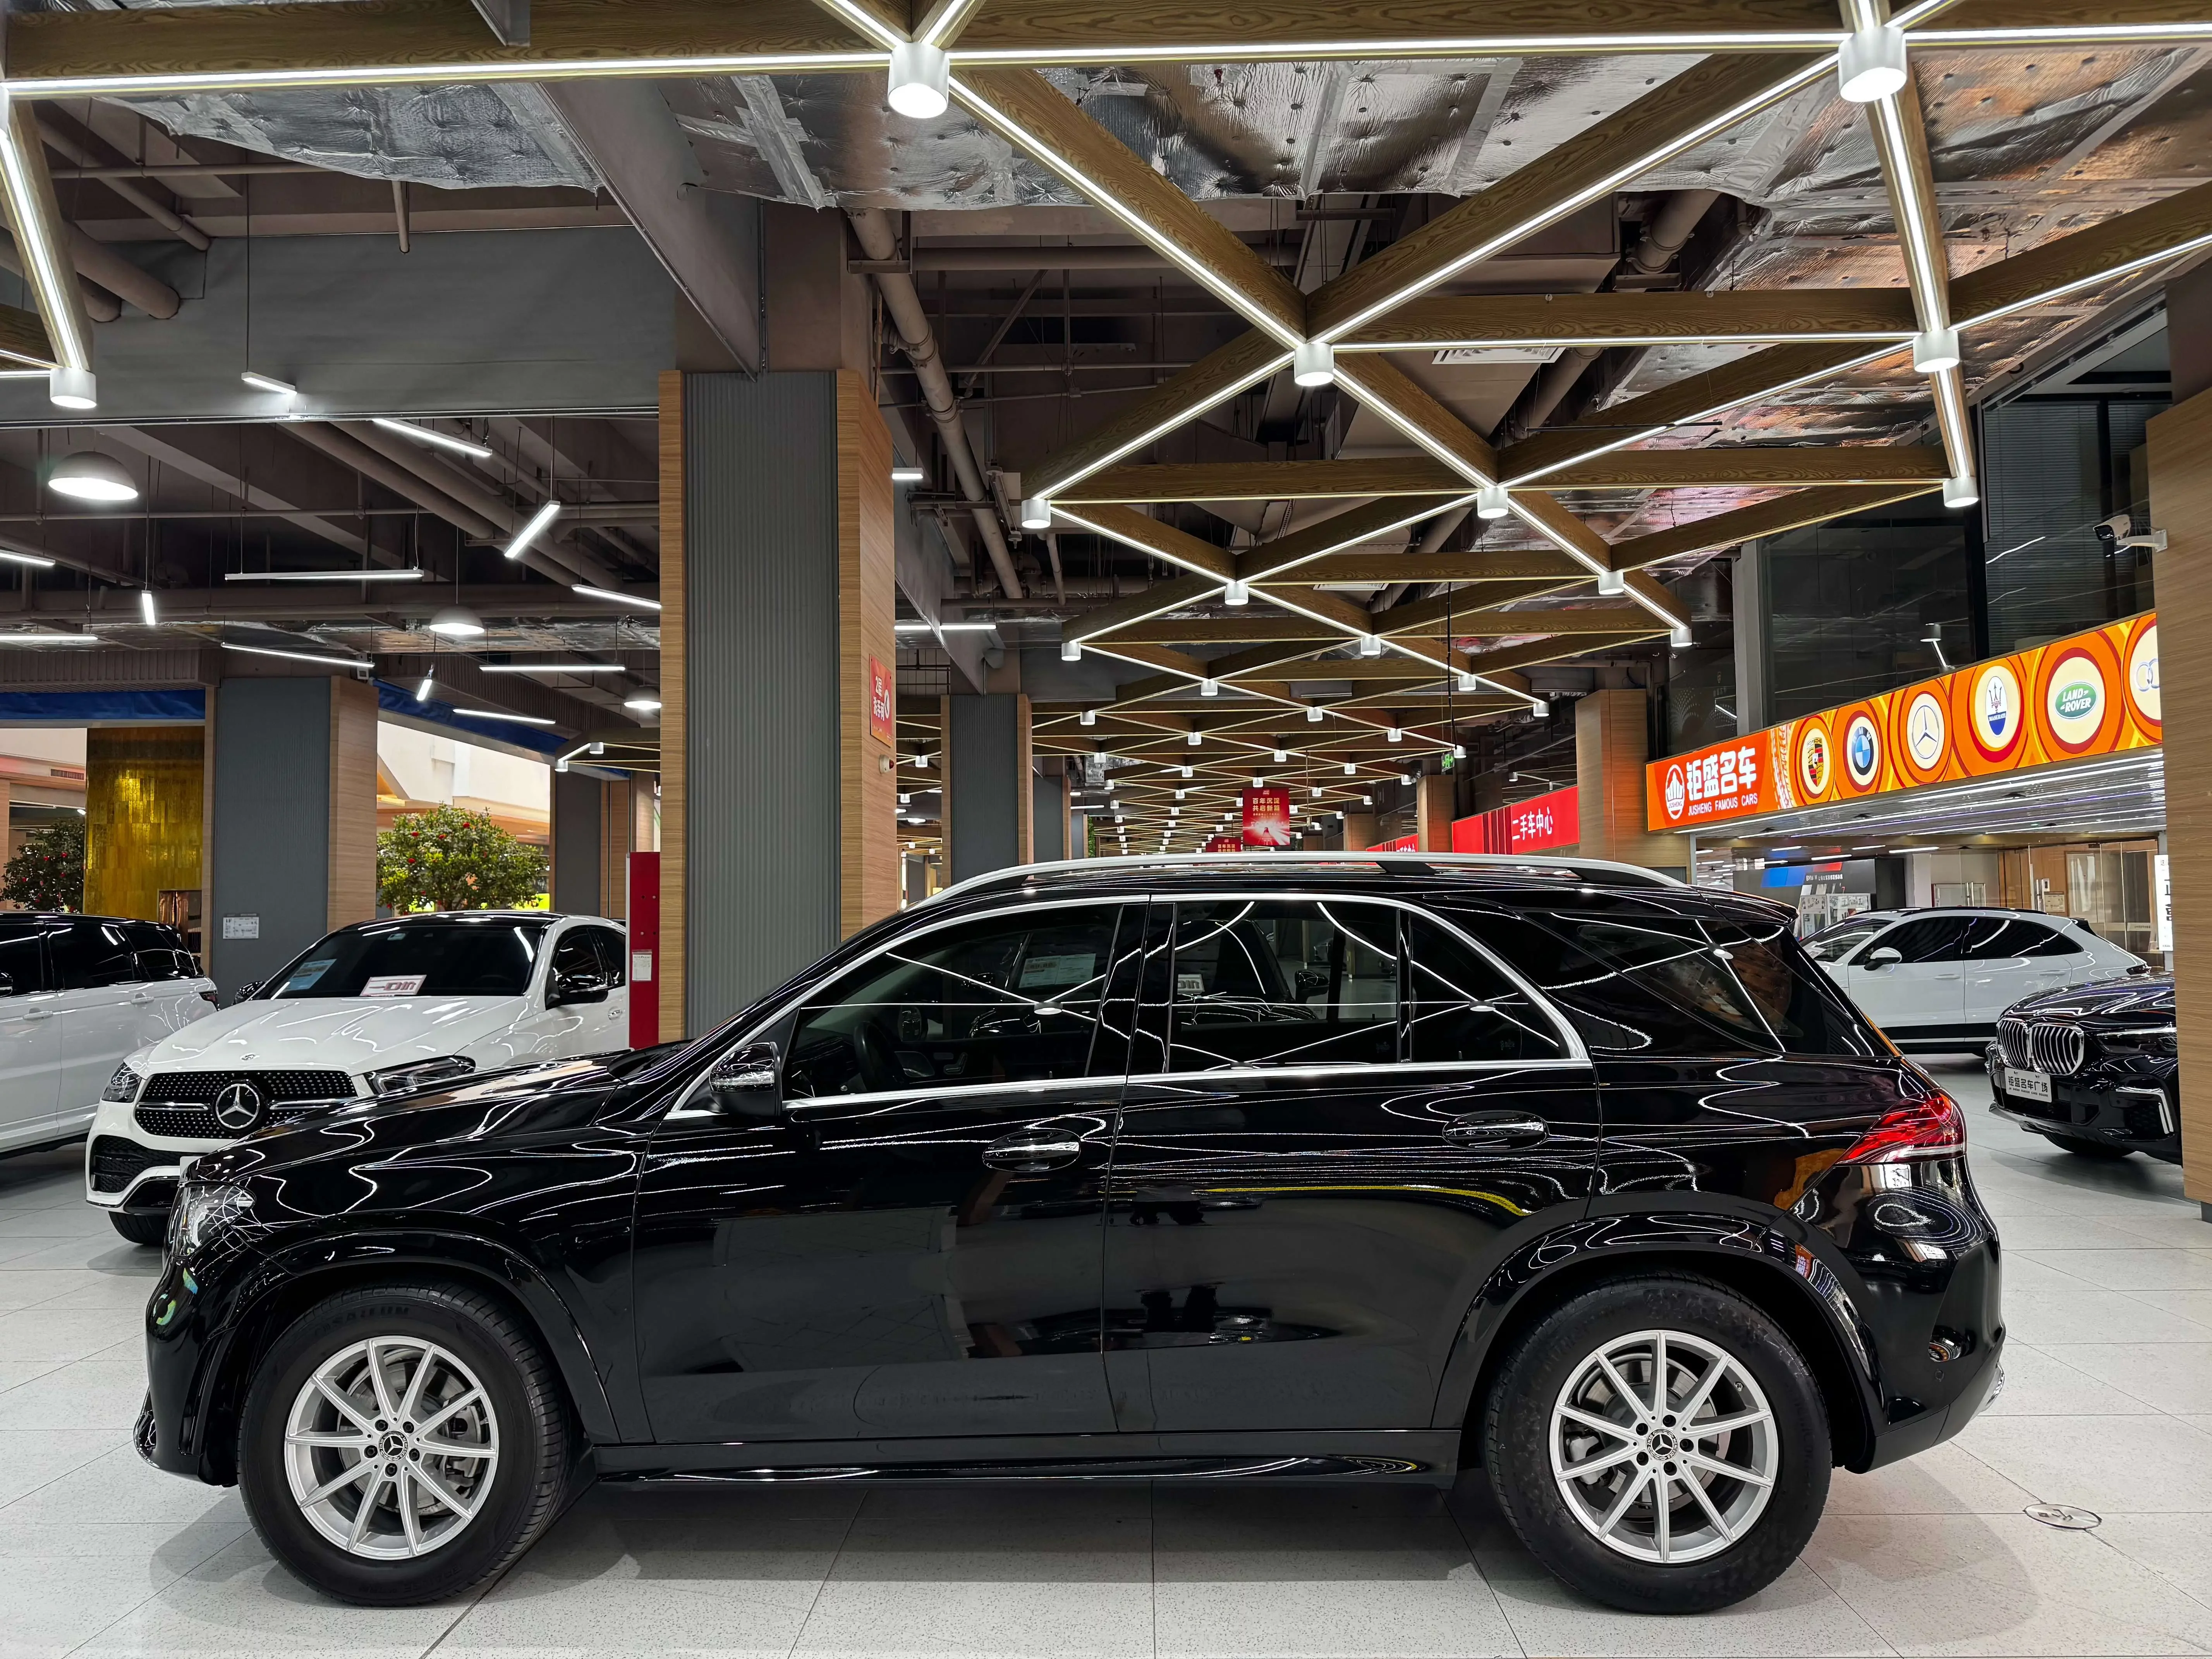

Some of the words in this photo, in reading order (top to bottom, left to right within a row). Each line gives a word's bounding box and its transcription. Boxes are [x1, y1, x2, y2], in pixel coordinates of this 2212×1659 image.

[2062, 688, 2085, 702] LAND
[2064, 697, 2091, 713] ROVER
[1686, 746, 1757, 801] 钜盛名车
[1688, 802, 1712, 816] JUSHENG
[1715, 797, 1738, 811] FAMOUS
[1741, 793, 1758, 807] CARS
[1512, 806, 1553, 840] 二手车中心
[2008, 1076, 2048, 1092] 钜盛名车广场
